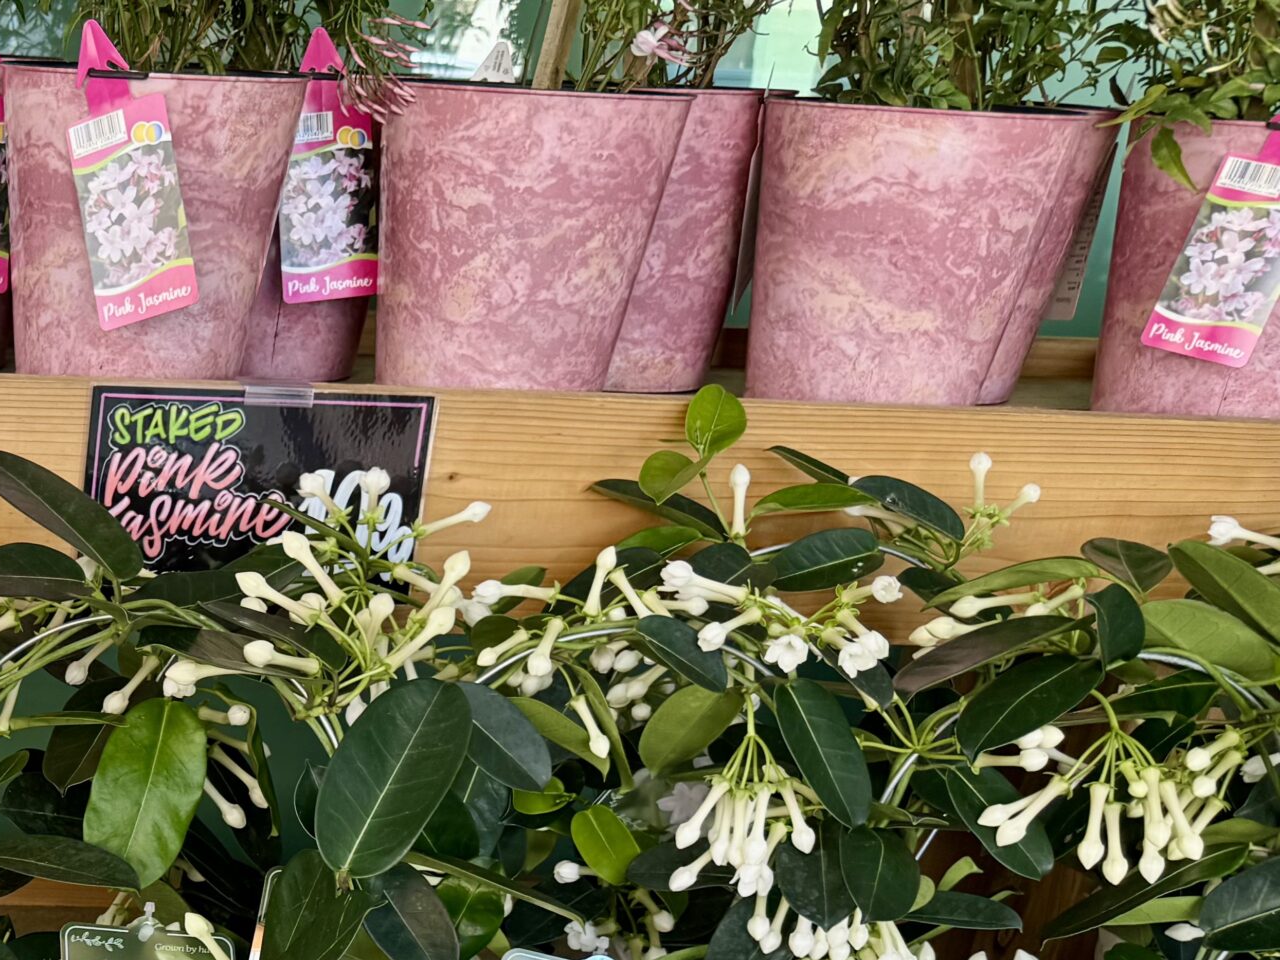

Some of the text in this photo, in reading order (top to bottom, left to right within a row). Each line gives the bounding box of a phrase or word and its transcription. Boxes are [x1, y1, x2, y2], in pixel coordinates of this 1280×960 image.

[103, 285, 191, 323] Pink Jasmine
[288, 276, 373, 297] Pink Jasmine
[1149, 322, 1245, 359] Pink Jasmine
[113, 403, 243, 445] STAKED
[154, 943, 184, 952] Grown
[186, 944, 197, 954] by
